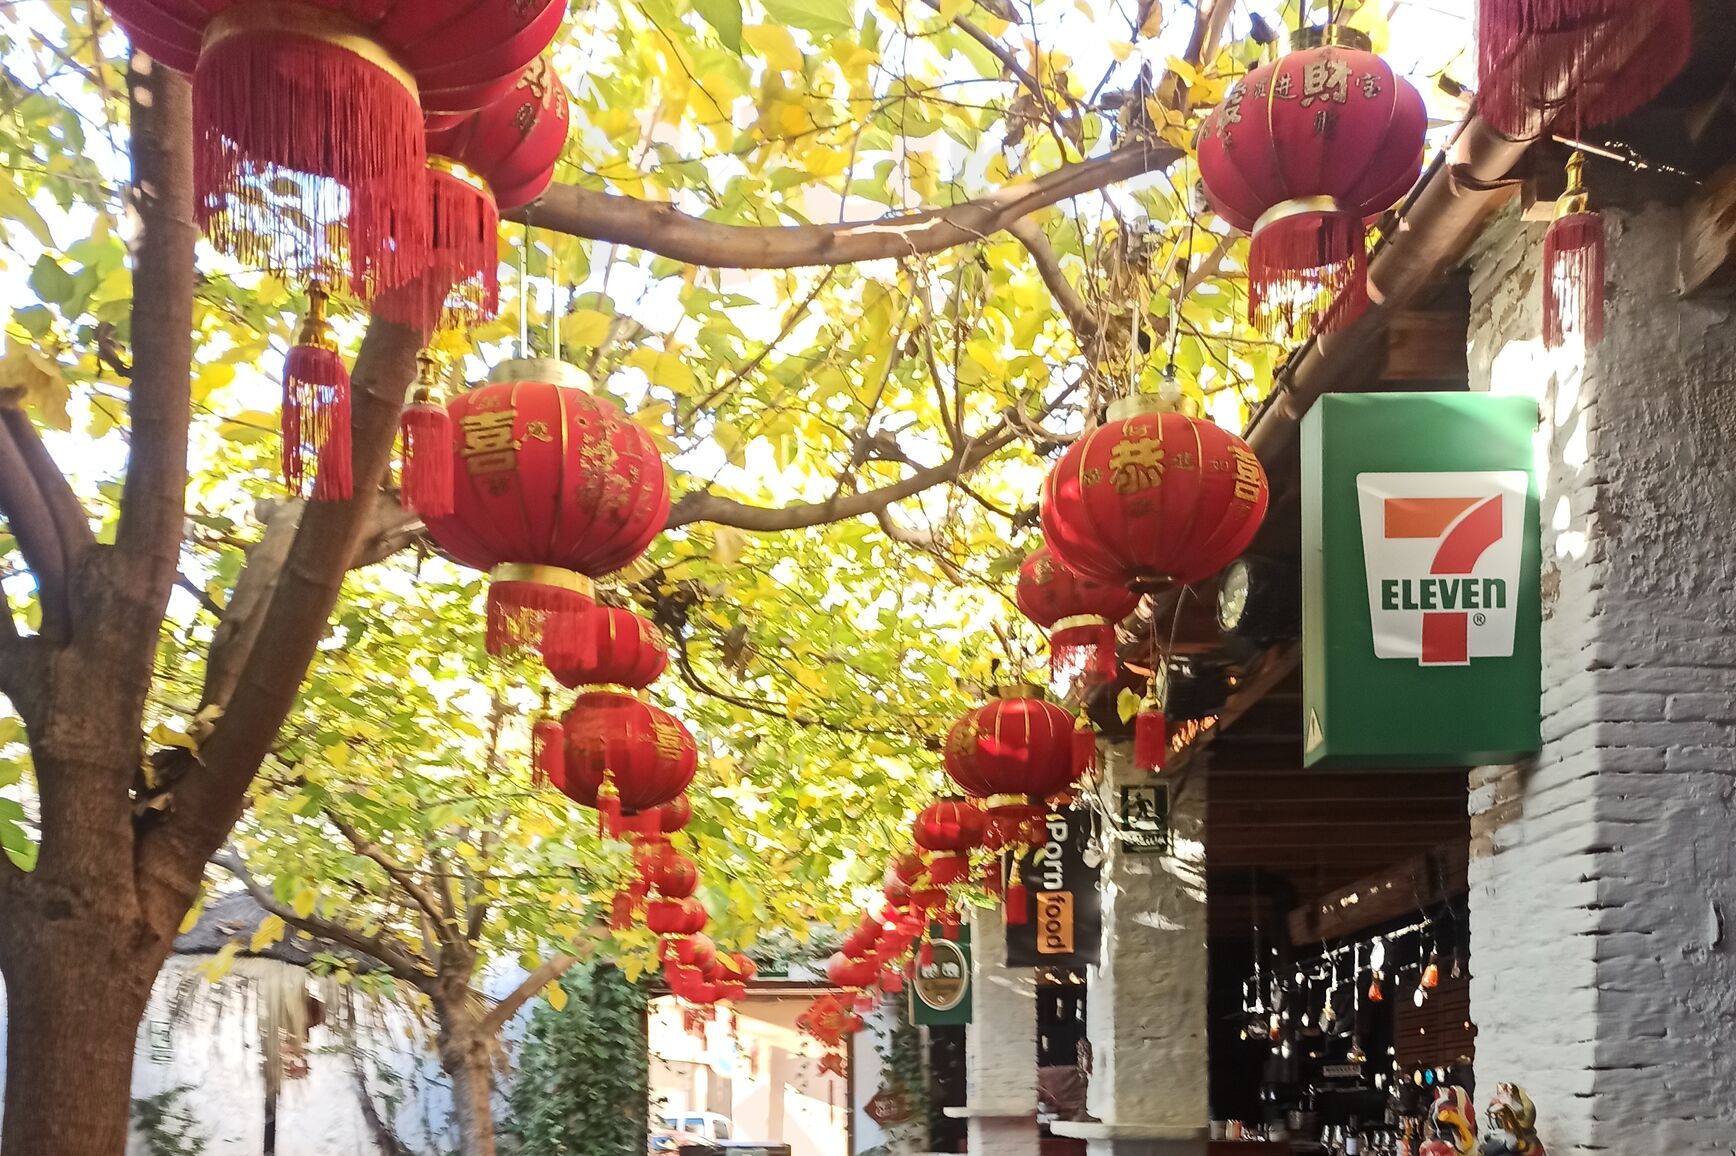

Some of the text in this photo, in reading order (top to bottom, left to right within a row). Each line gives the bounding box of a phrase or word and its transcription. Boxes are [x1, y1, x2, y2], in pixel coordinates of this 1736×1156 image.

[1108, 437, 1166, 496] 恭
[1384, 494, 1503, 663] 7
[1045, 895, 1066, 948] food
